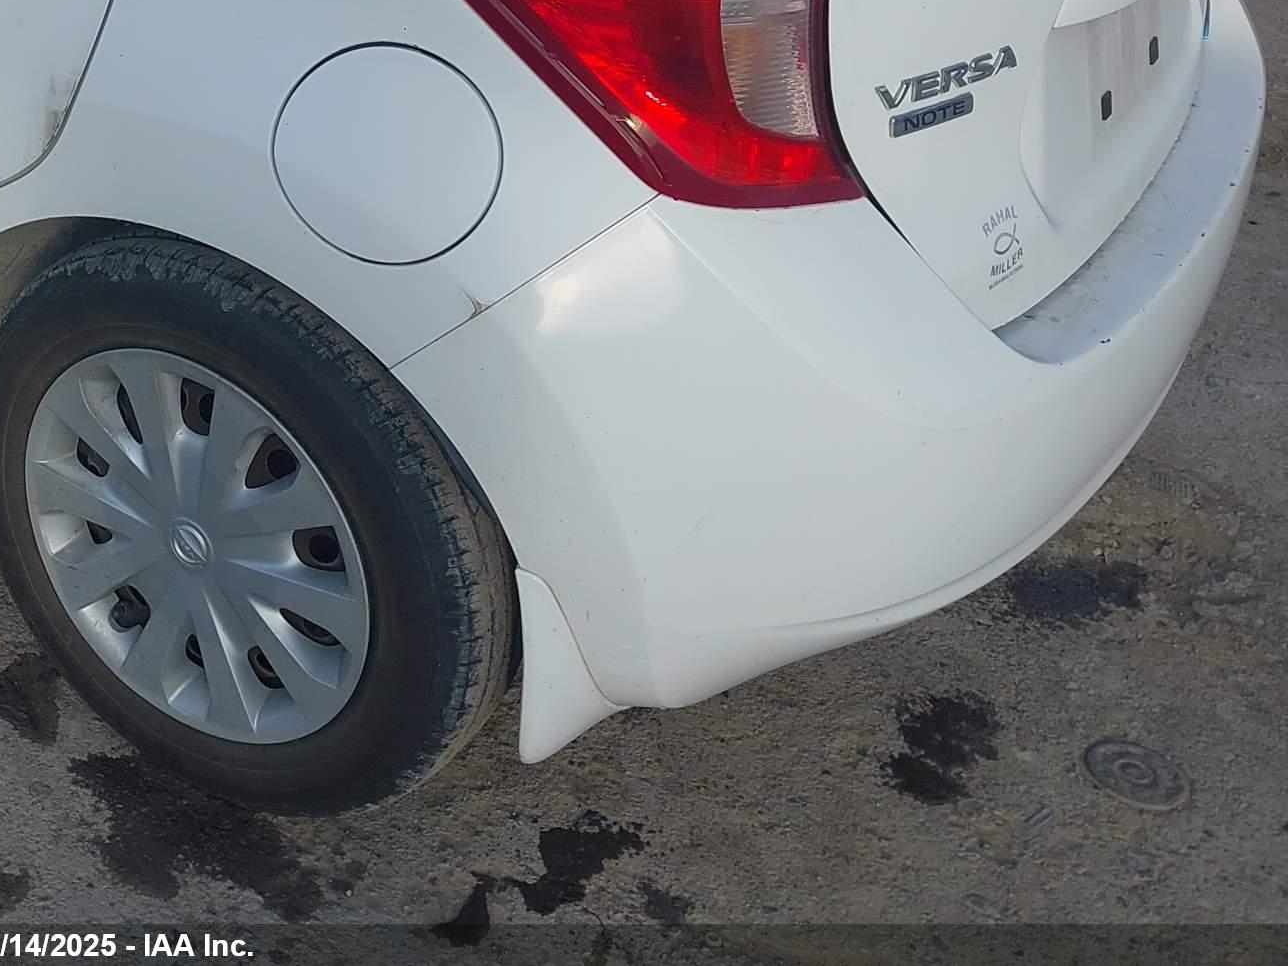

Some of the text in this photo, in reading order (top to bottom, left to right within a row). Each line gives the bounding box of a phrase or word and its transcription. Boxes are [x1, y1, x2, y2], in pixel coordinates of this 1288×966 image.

[874, 44, 1019, 112] VERSA
[901, 97, 968, 133] NOTE
[981, 204, 1019, 238] RAHAL
[990, 246, 1024, 278] MILLER
